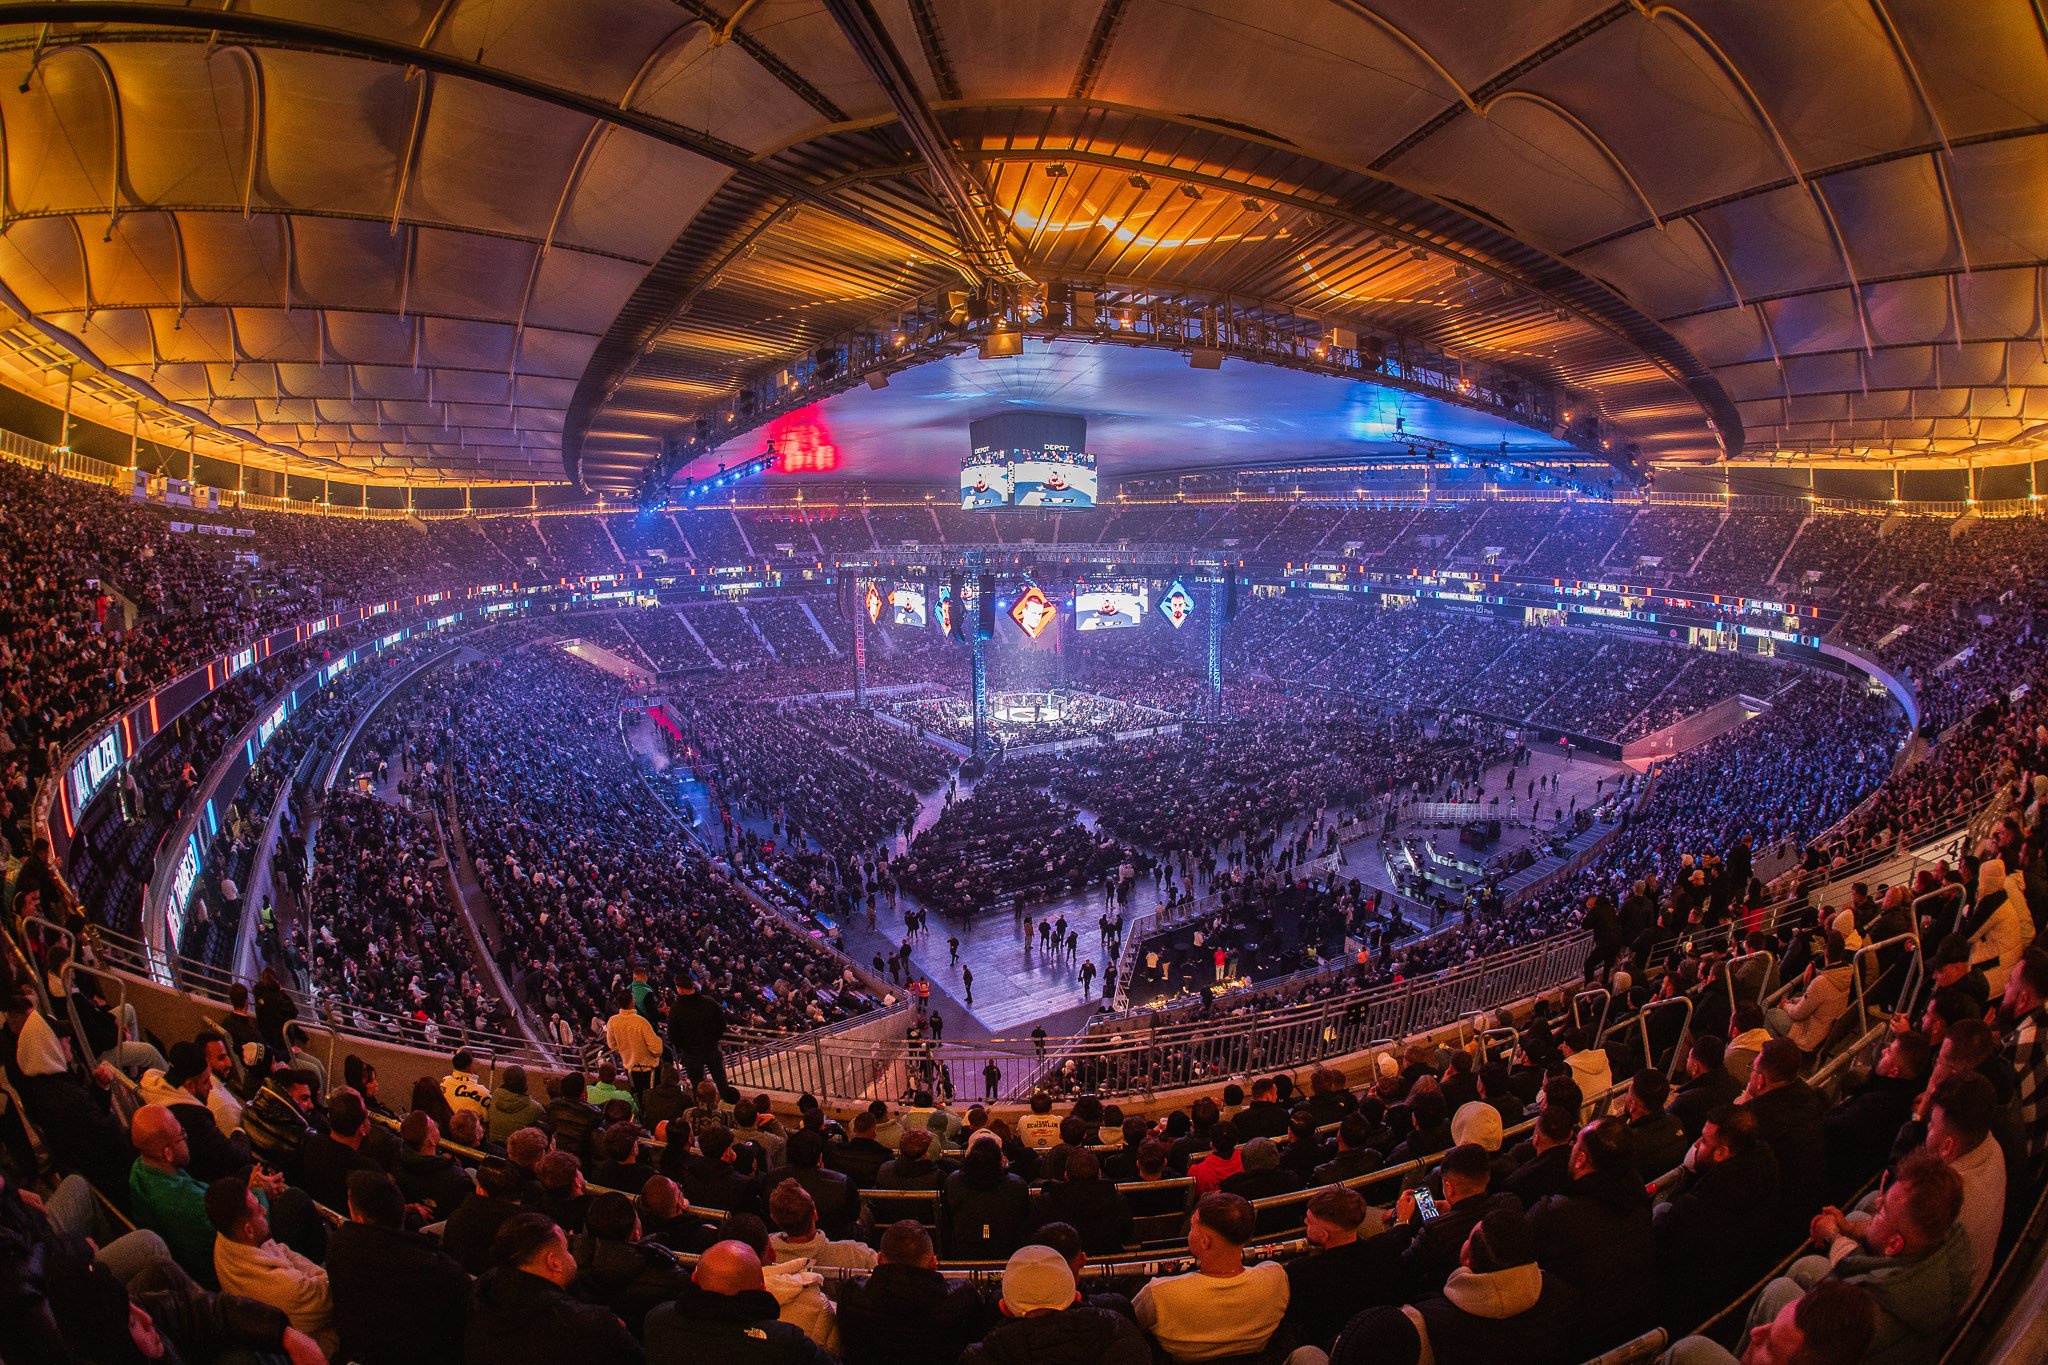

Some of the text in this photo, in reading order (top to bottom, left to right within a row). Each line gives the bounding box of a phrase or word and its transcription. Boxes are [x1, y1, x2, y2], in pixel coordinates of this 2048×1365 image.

[1044, 444, 1070, 452] DEPOT
[1590, 620, 1659, 636] Jüren-Grabowski-Tribüne
[623, 667, 630, 676] 2
[1665, 736, 1674, 749] 4
